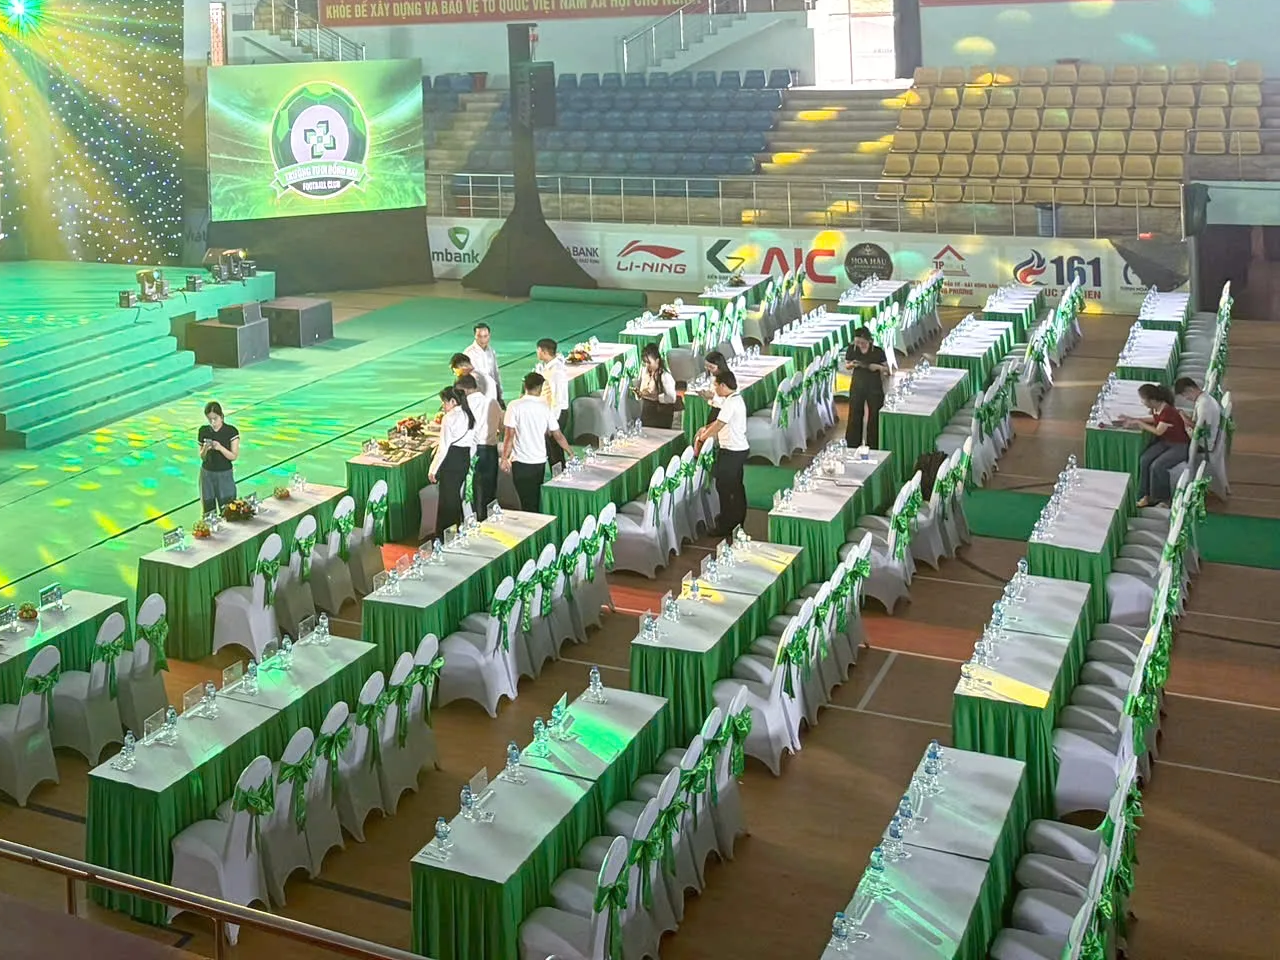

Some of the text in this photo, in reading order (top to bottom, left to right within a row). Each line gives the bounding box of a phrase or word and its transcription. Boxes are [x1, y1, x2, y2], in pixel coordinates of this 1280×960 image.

[326, 0, 352, 19] KHỎE
[370, 0, 391, 17] XÂY
[393, 1, 421, 20] DỰNG
[424, 0, 439, 16] VÀ
[431, 248, 480, 264] mbank
[572, 246, 600, 258] BANK
[616, 260, 687, 274] LI-NING
[1049, 255, 1102, 287] 161
